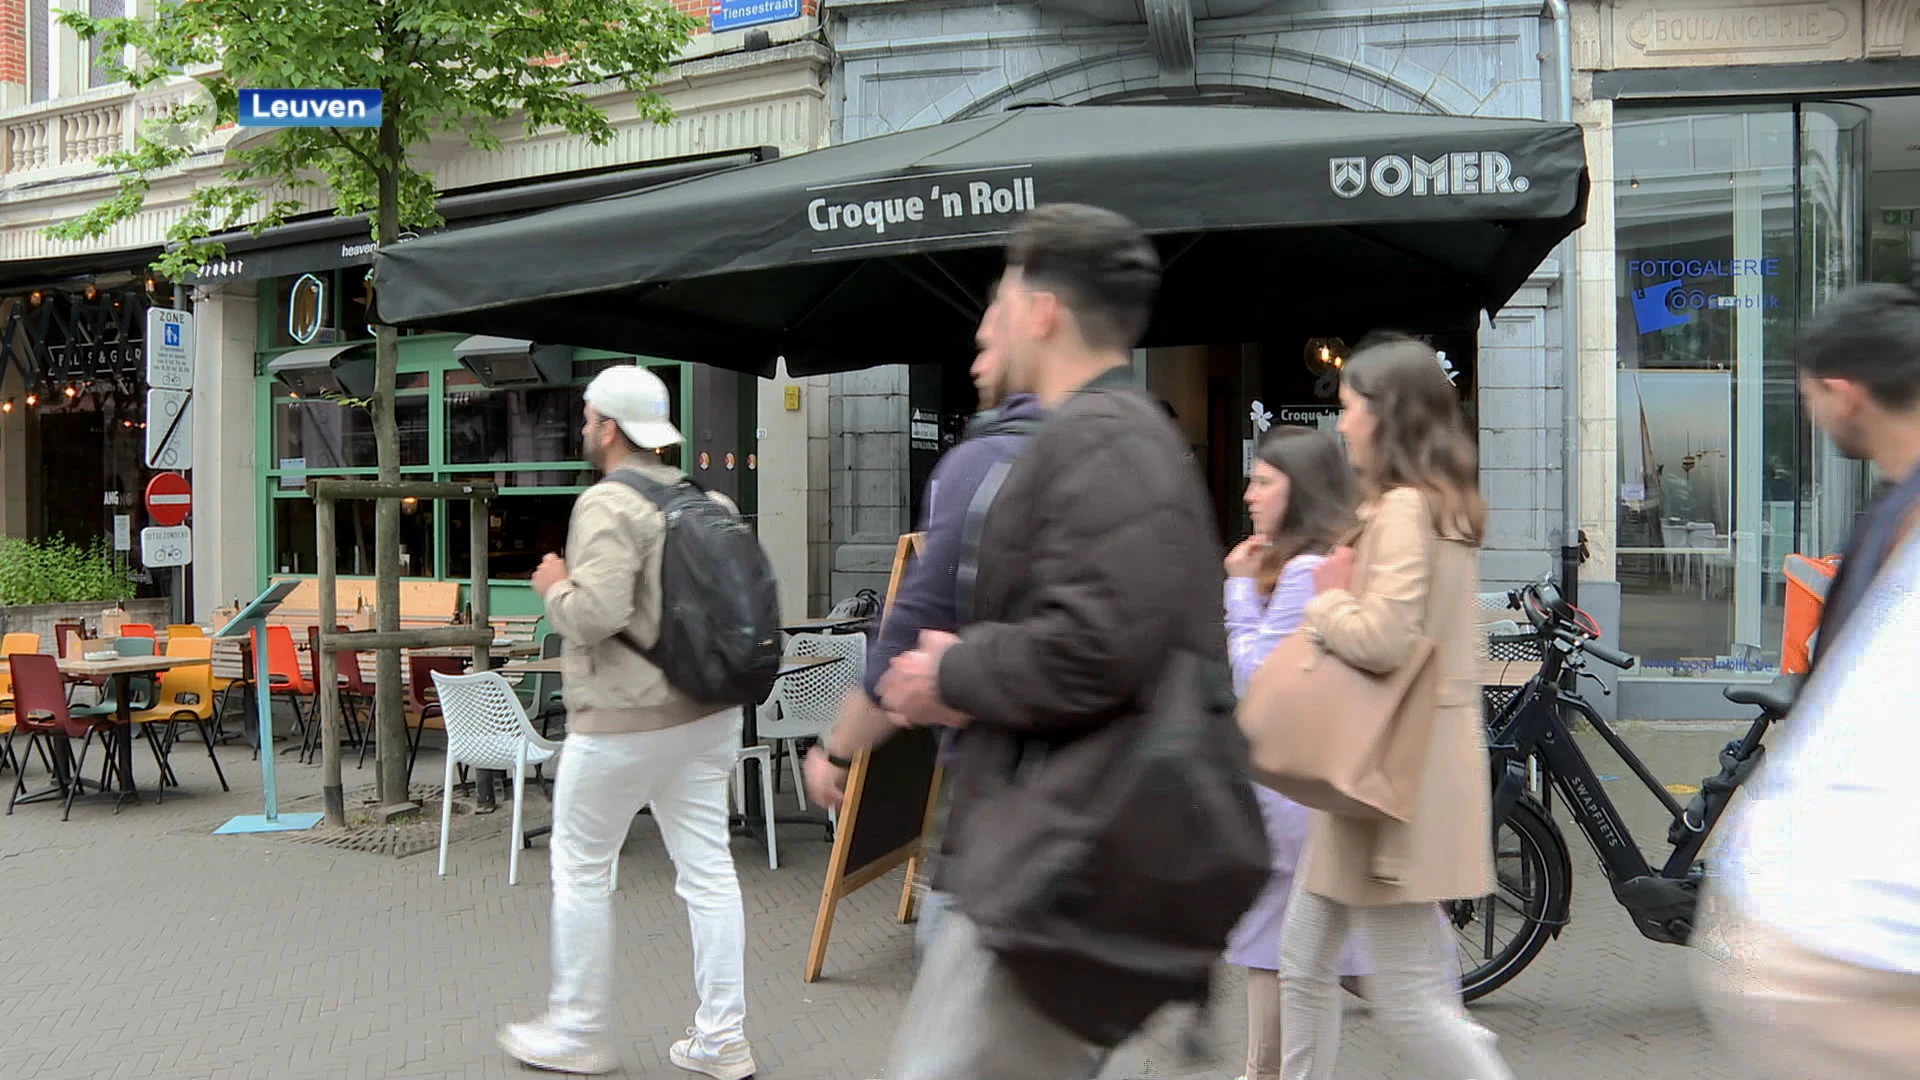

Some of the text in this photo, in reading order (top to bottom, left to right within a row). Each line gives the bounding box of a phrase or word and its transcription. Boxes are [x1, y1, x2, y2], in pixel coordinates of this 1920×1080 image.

[722, 0, 794, 20] Tiensestraat
[1656, 10, 1820, 41] BOULANGERIE
[807, 195, 925, 234] Croque
[969, 177, 1036, 215] Roll
[1628, 259, 1779, 277] FOTOGALERIE
[160, 311, 185, 324] ZONE
[1280, 408, 1323, 424] Croque
[1571, 777, 1618, 847] SWAPFIETS
